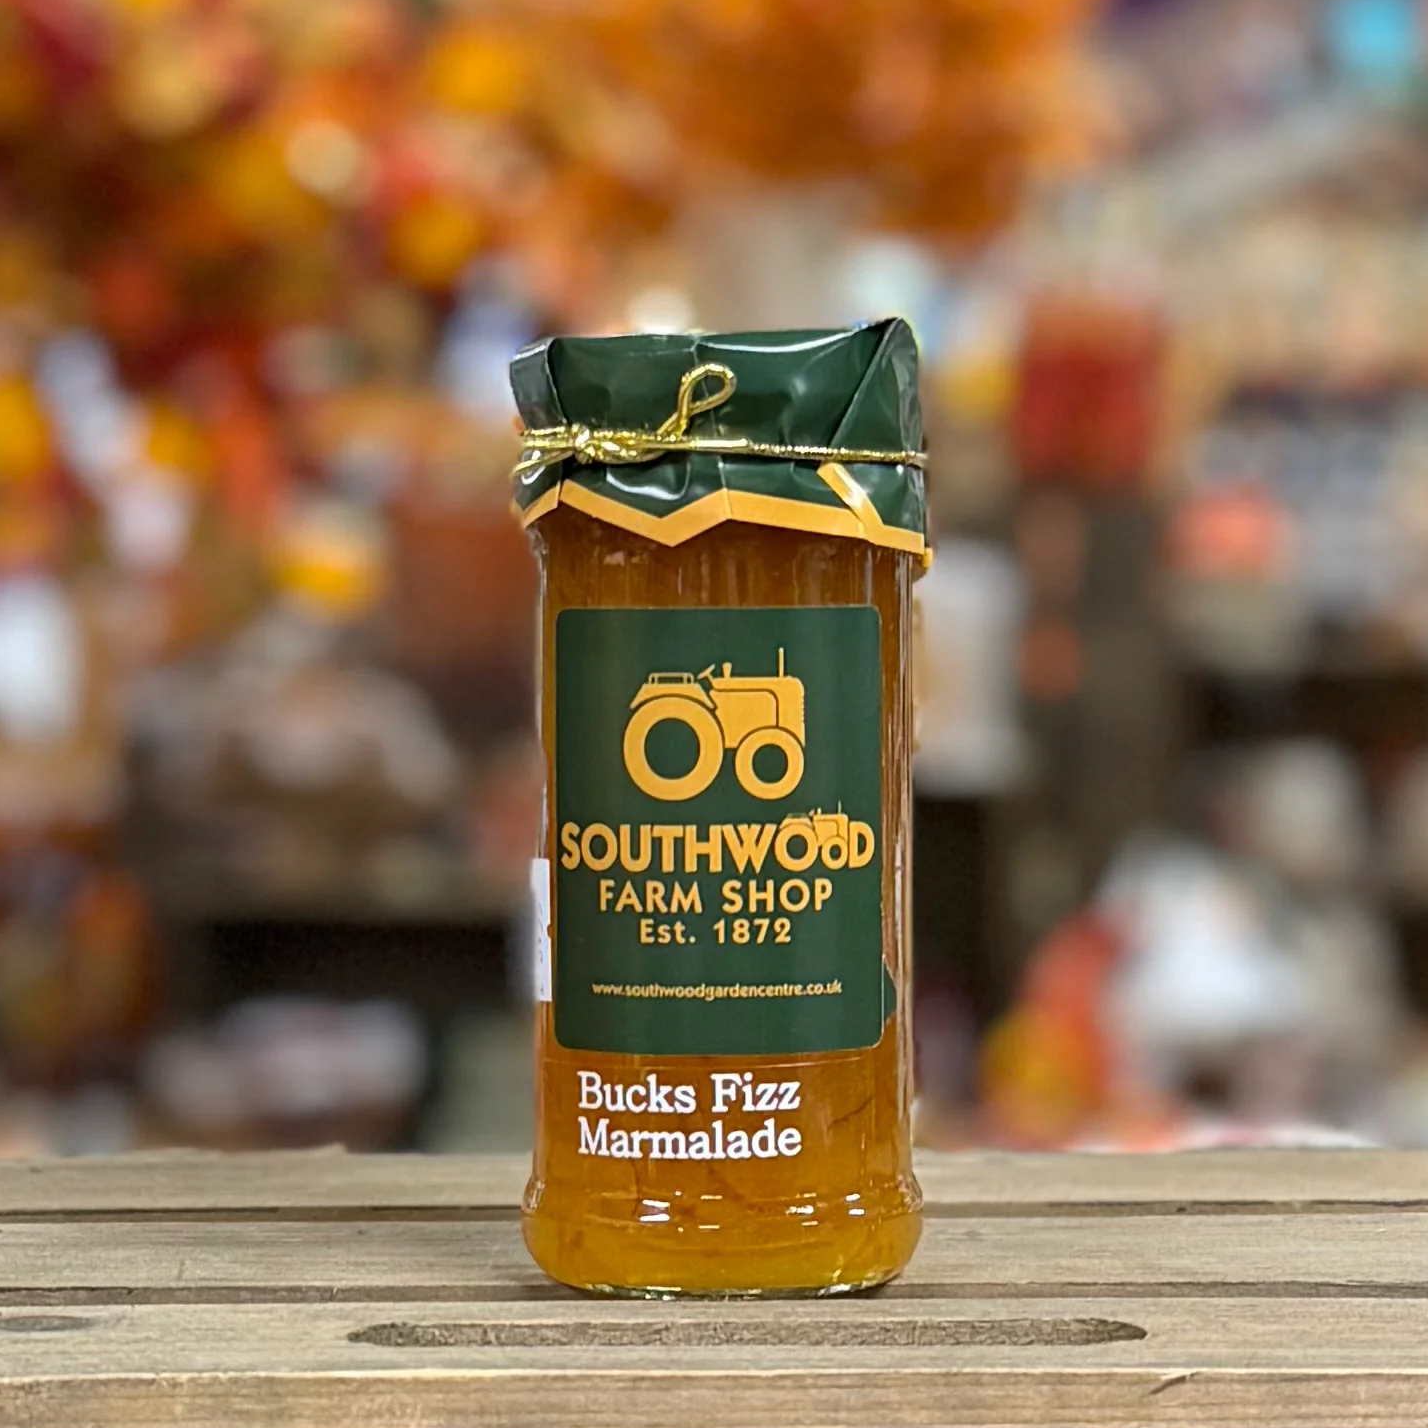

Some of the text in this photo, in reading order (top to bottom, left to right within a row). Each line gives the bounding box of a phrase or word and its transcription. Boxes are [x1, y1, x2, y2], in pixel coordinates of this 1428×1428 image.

[560, 820, 875, 874] SOUTHWOOD
[598, 877, 833, 914] FARM SHOP
[639, 917, 792, 944] Est. 1872
[591, 979, 843, 1001] www.southwoodgardencentre.co.uk
[576, 1070, 801, 1114] Bucks Fizz
[577, 1116, 803, 1160] Marmalade
